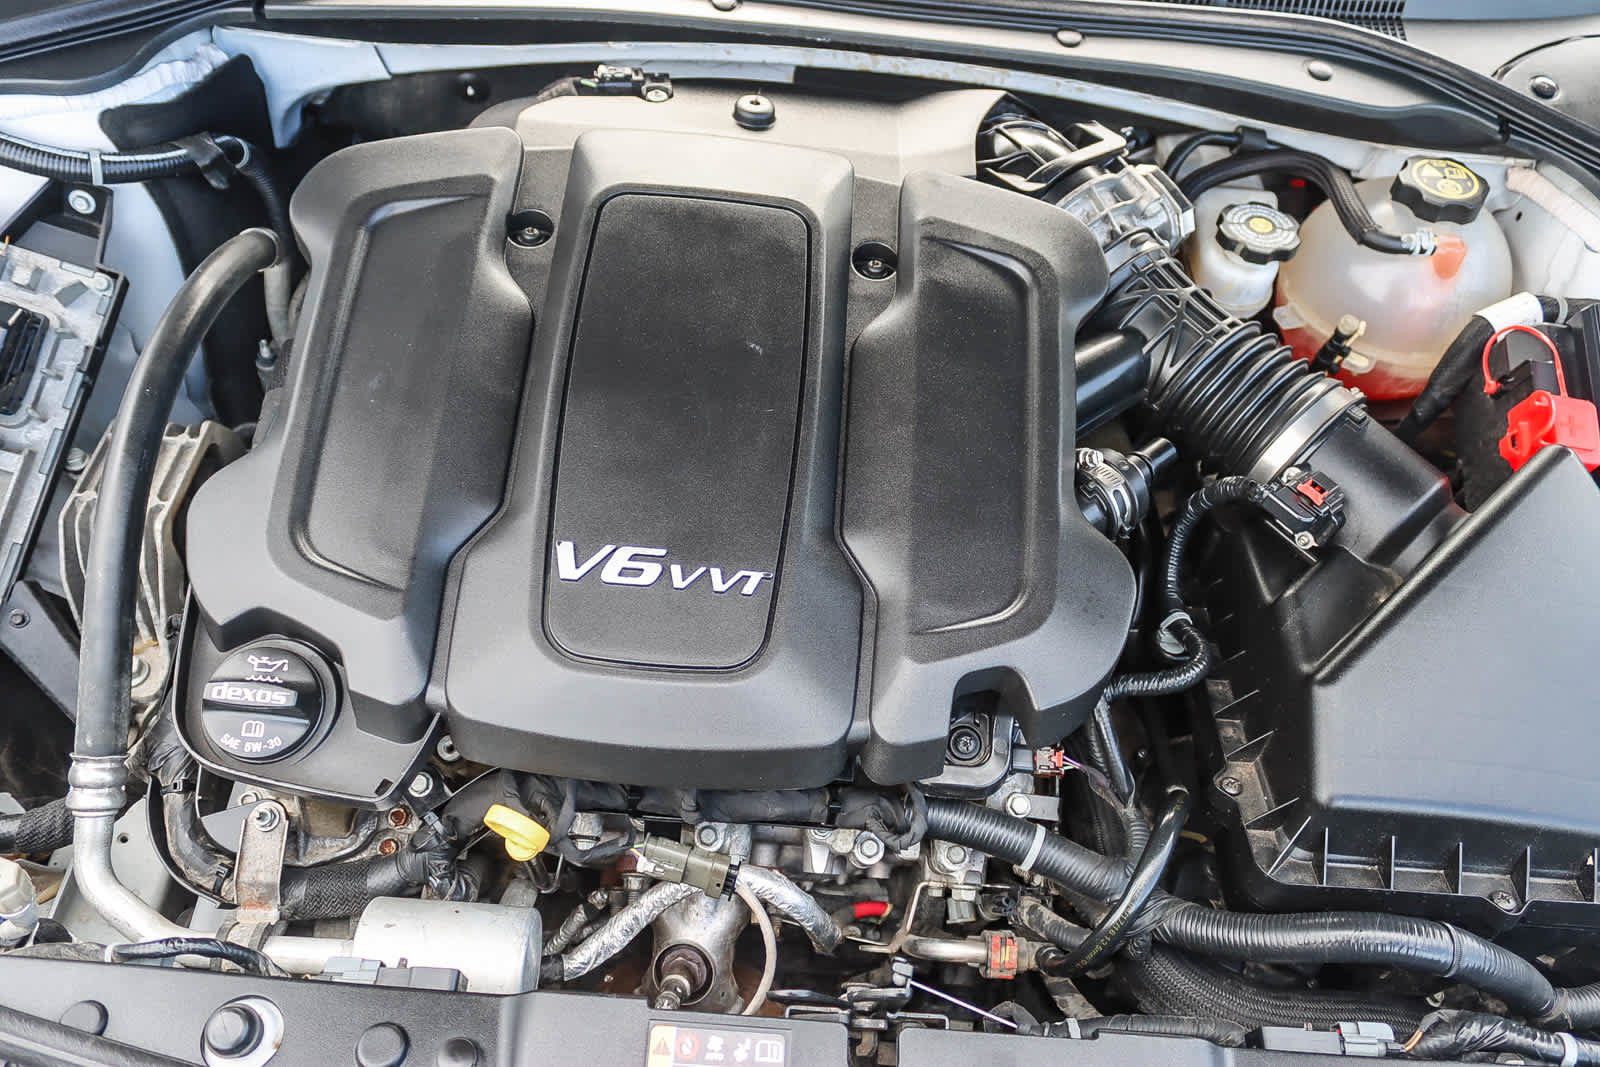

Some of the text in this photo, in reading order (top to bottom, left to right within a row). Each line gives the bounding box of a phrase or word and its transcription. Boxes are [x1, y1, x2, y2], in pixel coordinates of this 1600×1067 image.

[556, 540, 773, 596] V6 VVT
[211, 682, 291, 704] dexos
[220, 733, 241, 749] SAE
